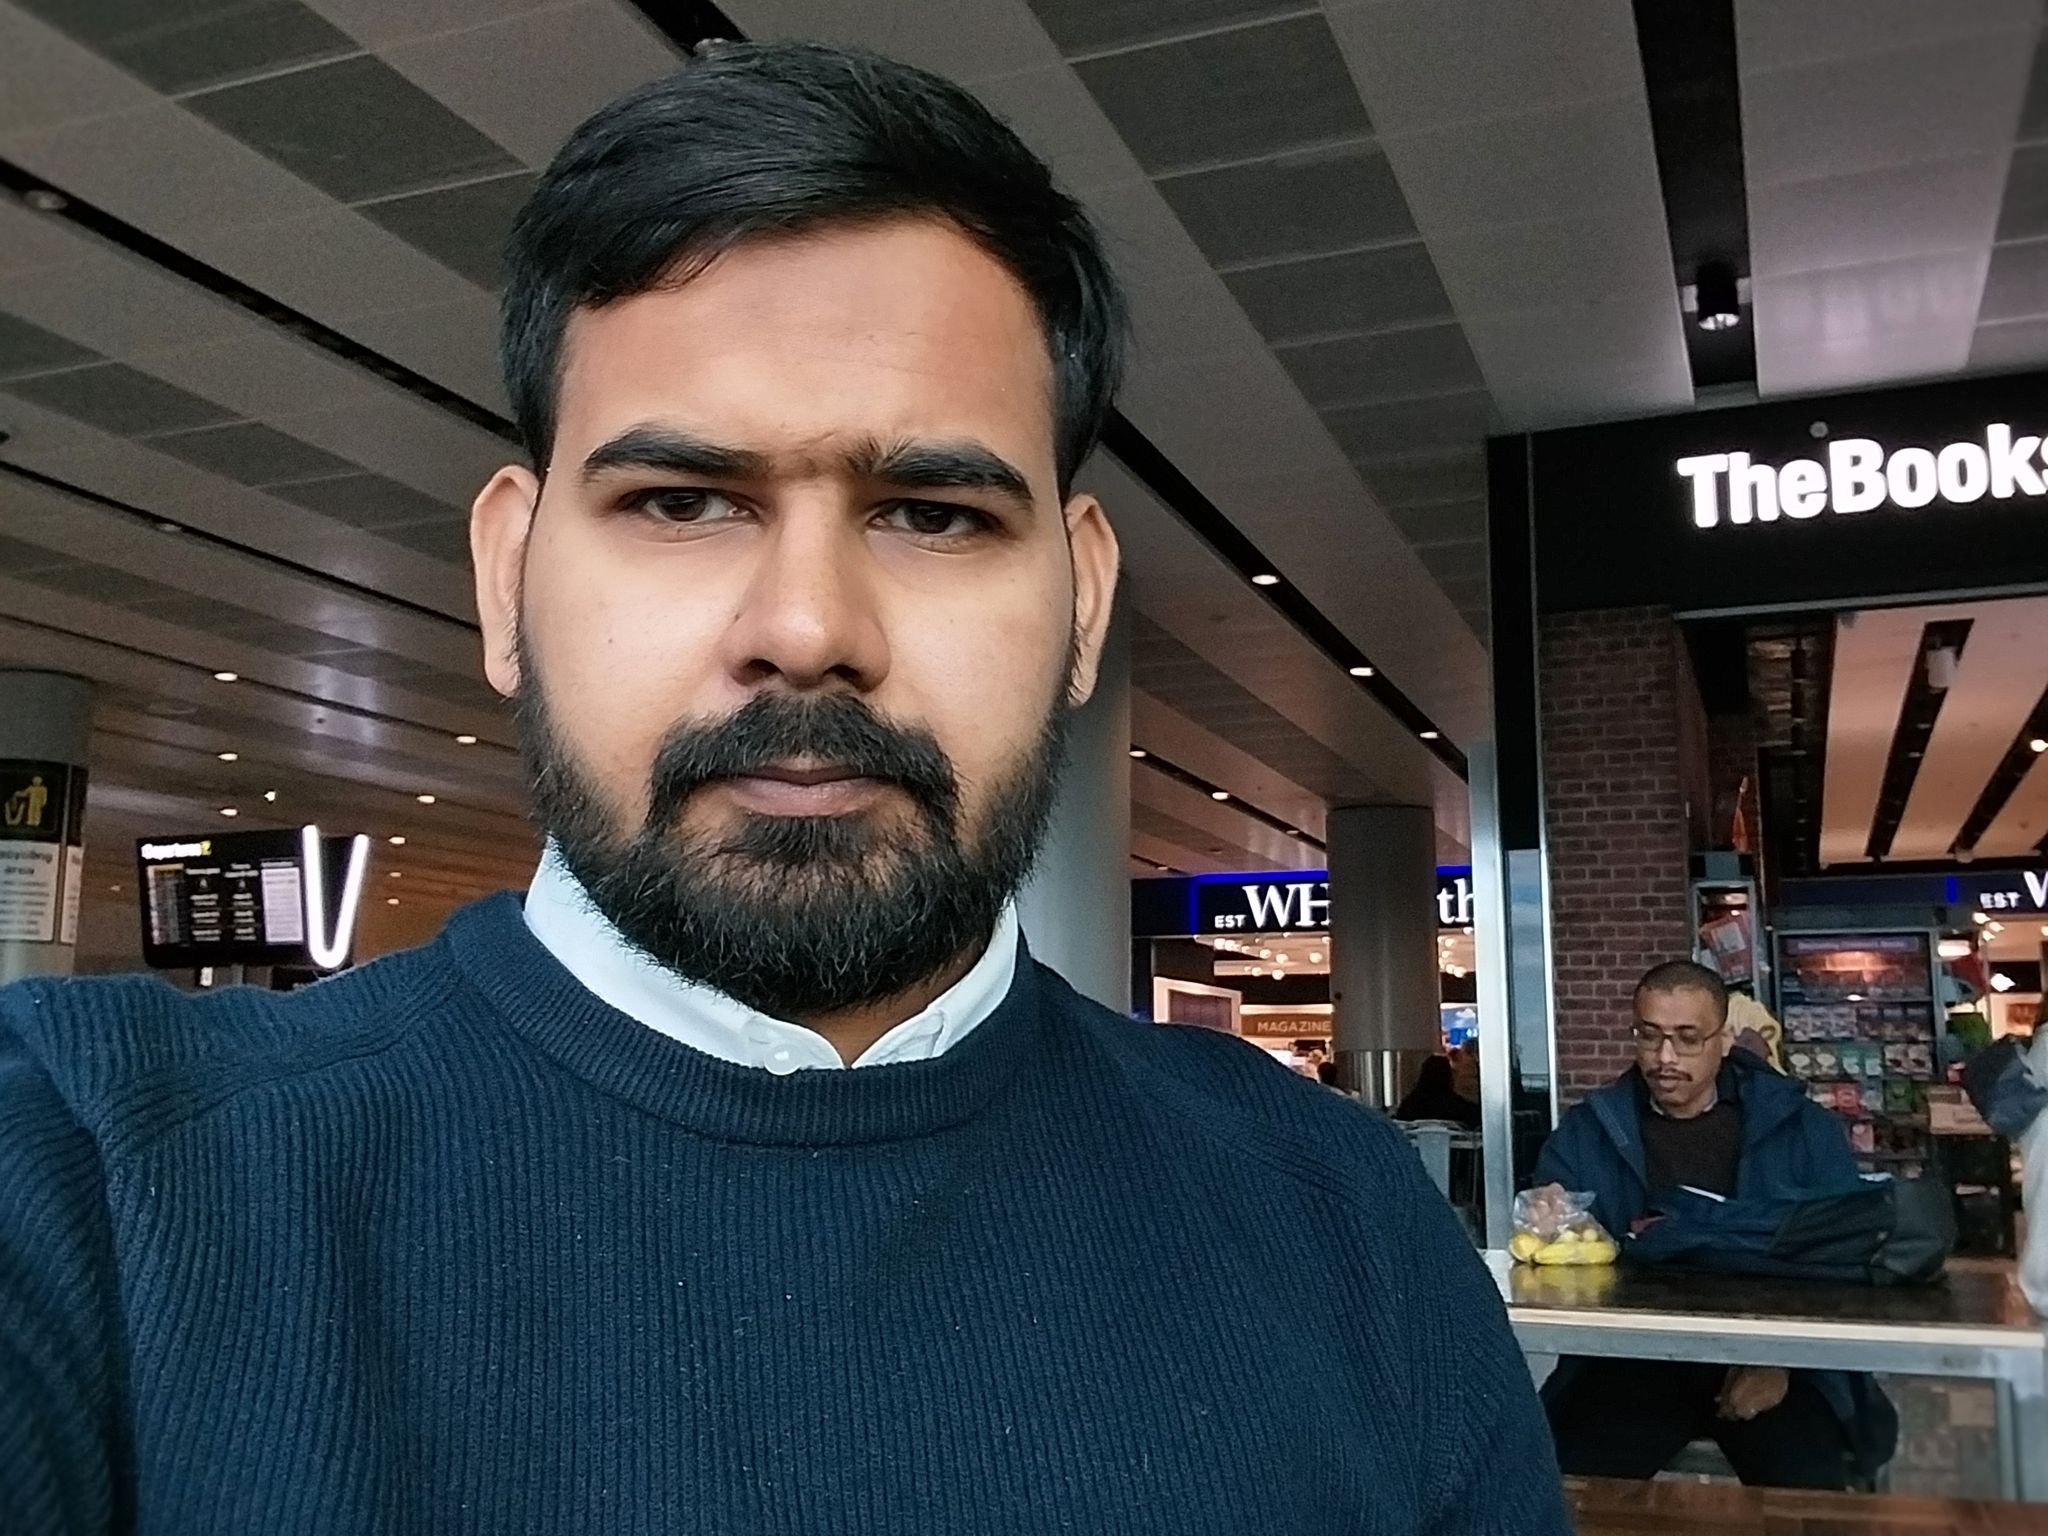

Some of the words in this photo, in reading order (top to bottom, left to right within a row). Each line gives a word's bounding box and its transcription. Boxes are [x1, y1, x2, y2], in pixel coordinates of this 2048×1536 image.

[1677, 423, 2048, 527] TheBook
[1980, 891, 2021, 909] EST
[1214, 914, 1246, 929] EST
